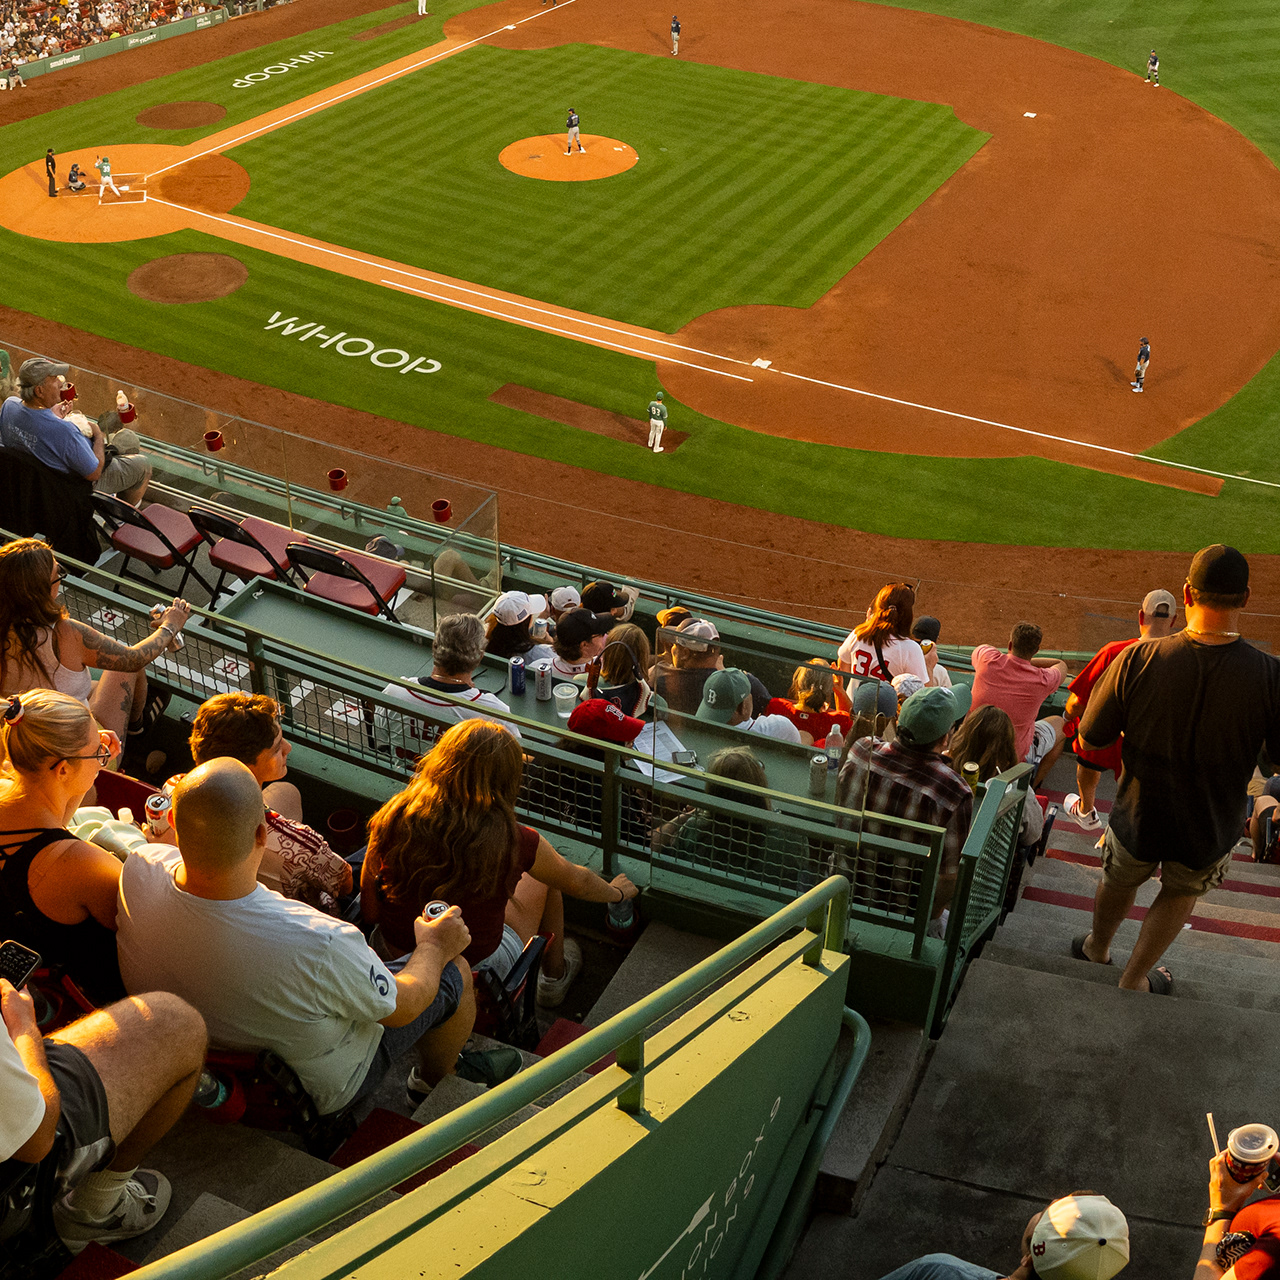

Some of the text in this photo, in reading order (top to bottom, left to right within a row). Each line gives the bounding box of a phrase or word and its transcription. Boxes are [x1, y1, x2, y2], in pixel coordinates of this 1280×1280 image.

[50, 54, 80, 68] smartwater
[232, 49, 334, 88] WHOOP
[263, 311, 442, 374] WHOOP
[707, 689, 717, 704] B
